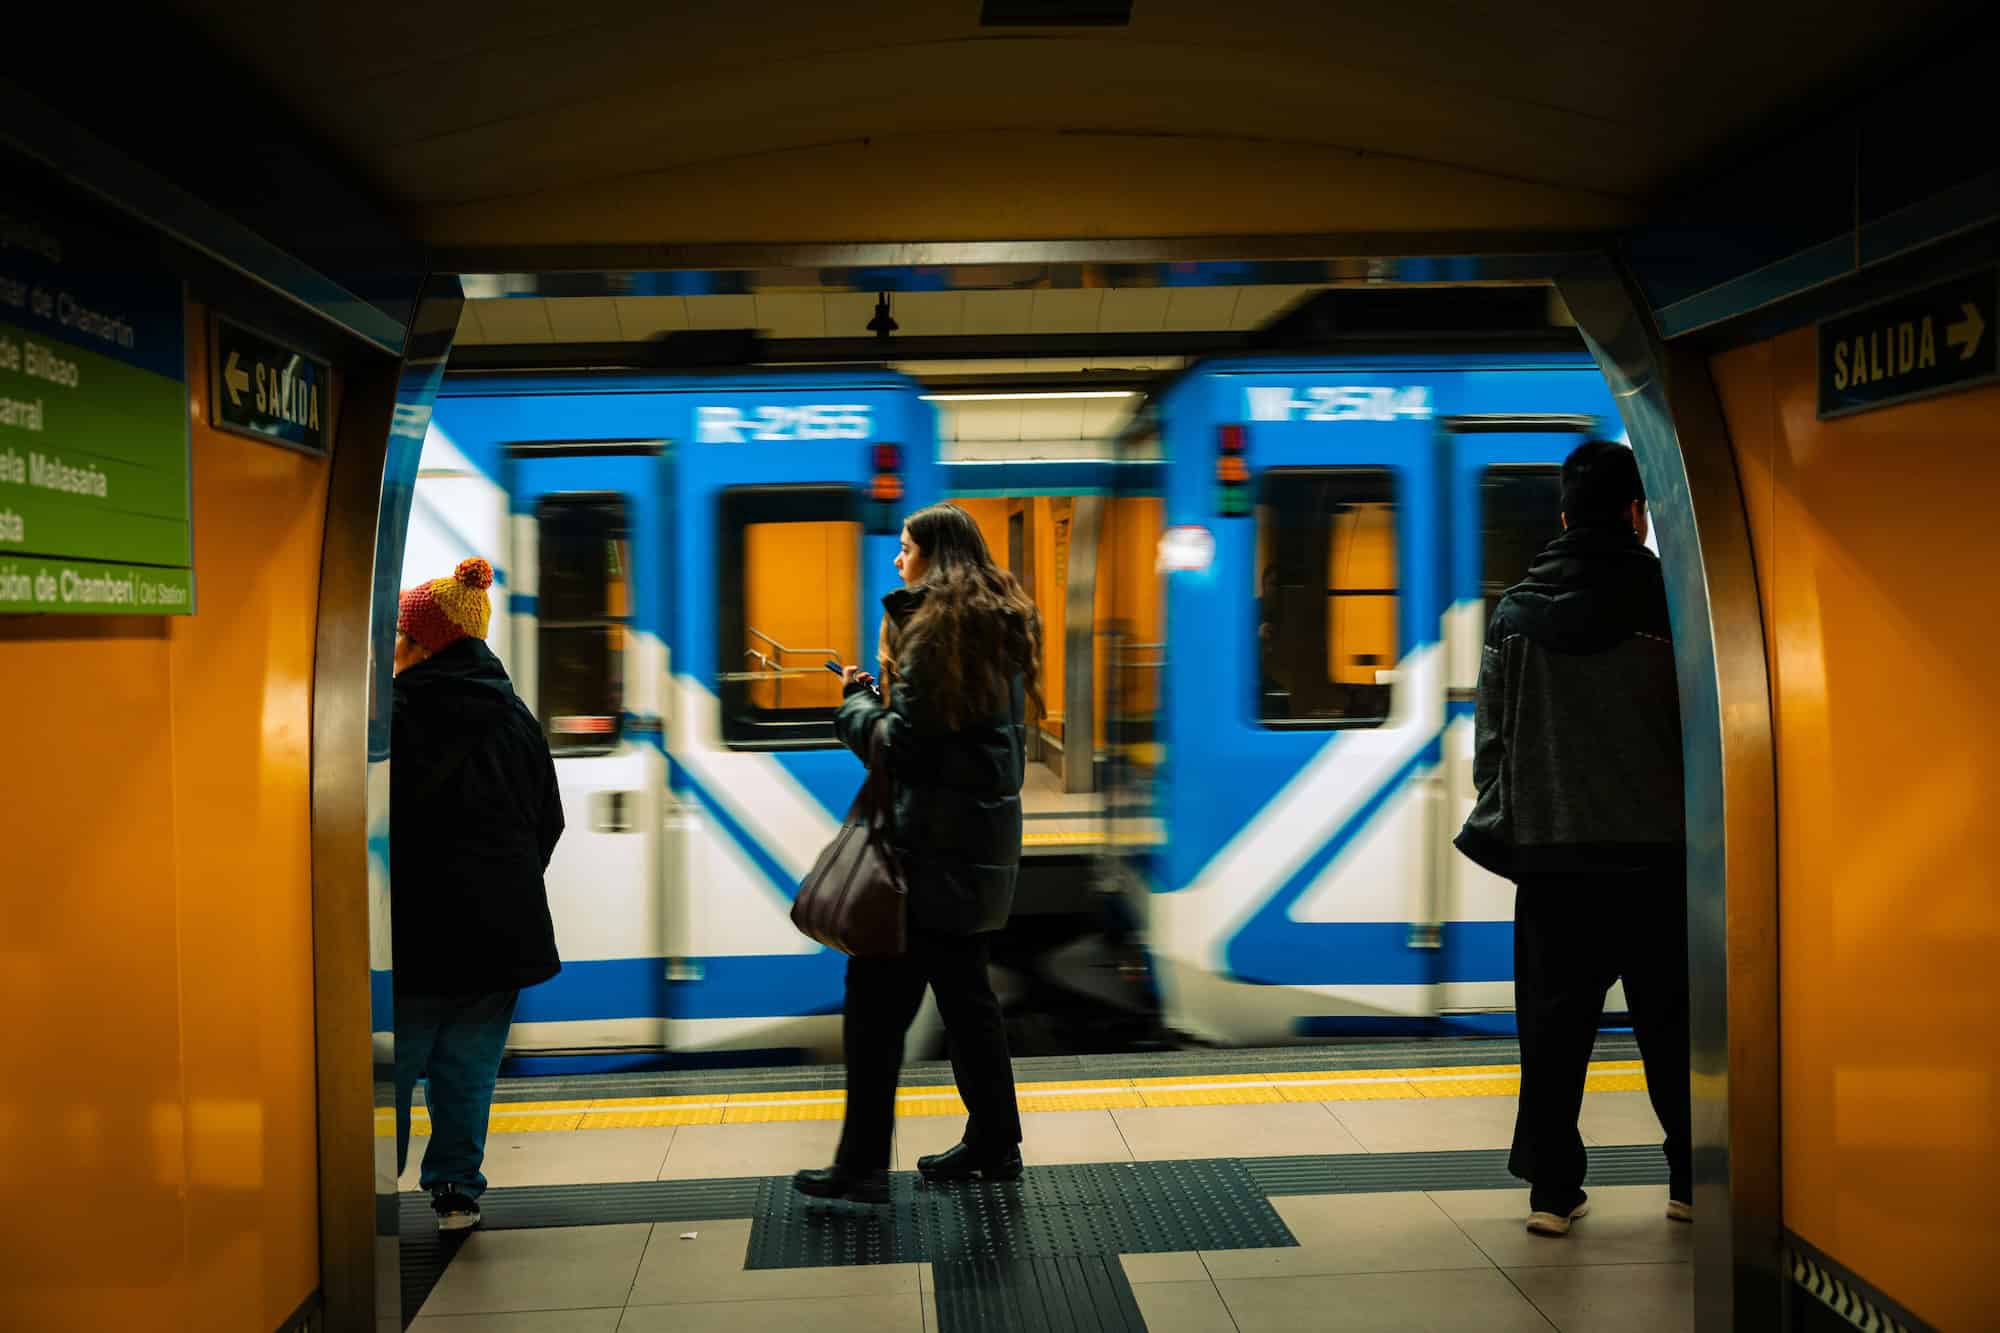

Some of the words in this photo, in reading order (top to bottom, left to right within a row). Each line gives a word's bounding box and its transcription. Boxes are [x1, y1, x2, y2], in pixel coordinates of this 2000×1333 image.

[24, 341, 79, 388] Bilbao
[1834, 315, 1936, 391] SALIDA
[255, 360, 319, 432] SALIDA
[29, 451, 107, 498] Malasaña
[35, 567, 57, 602] de
